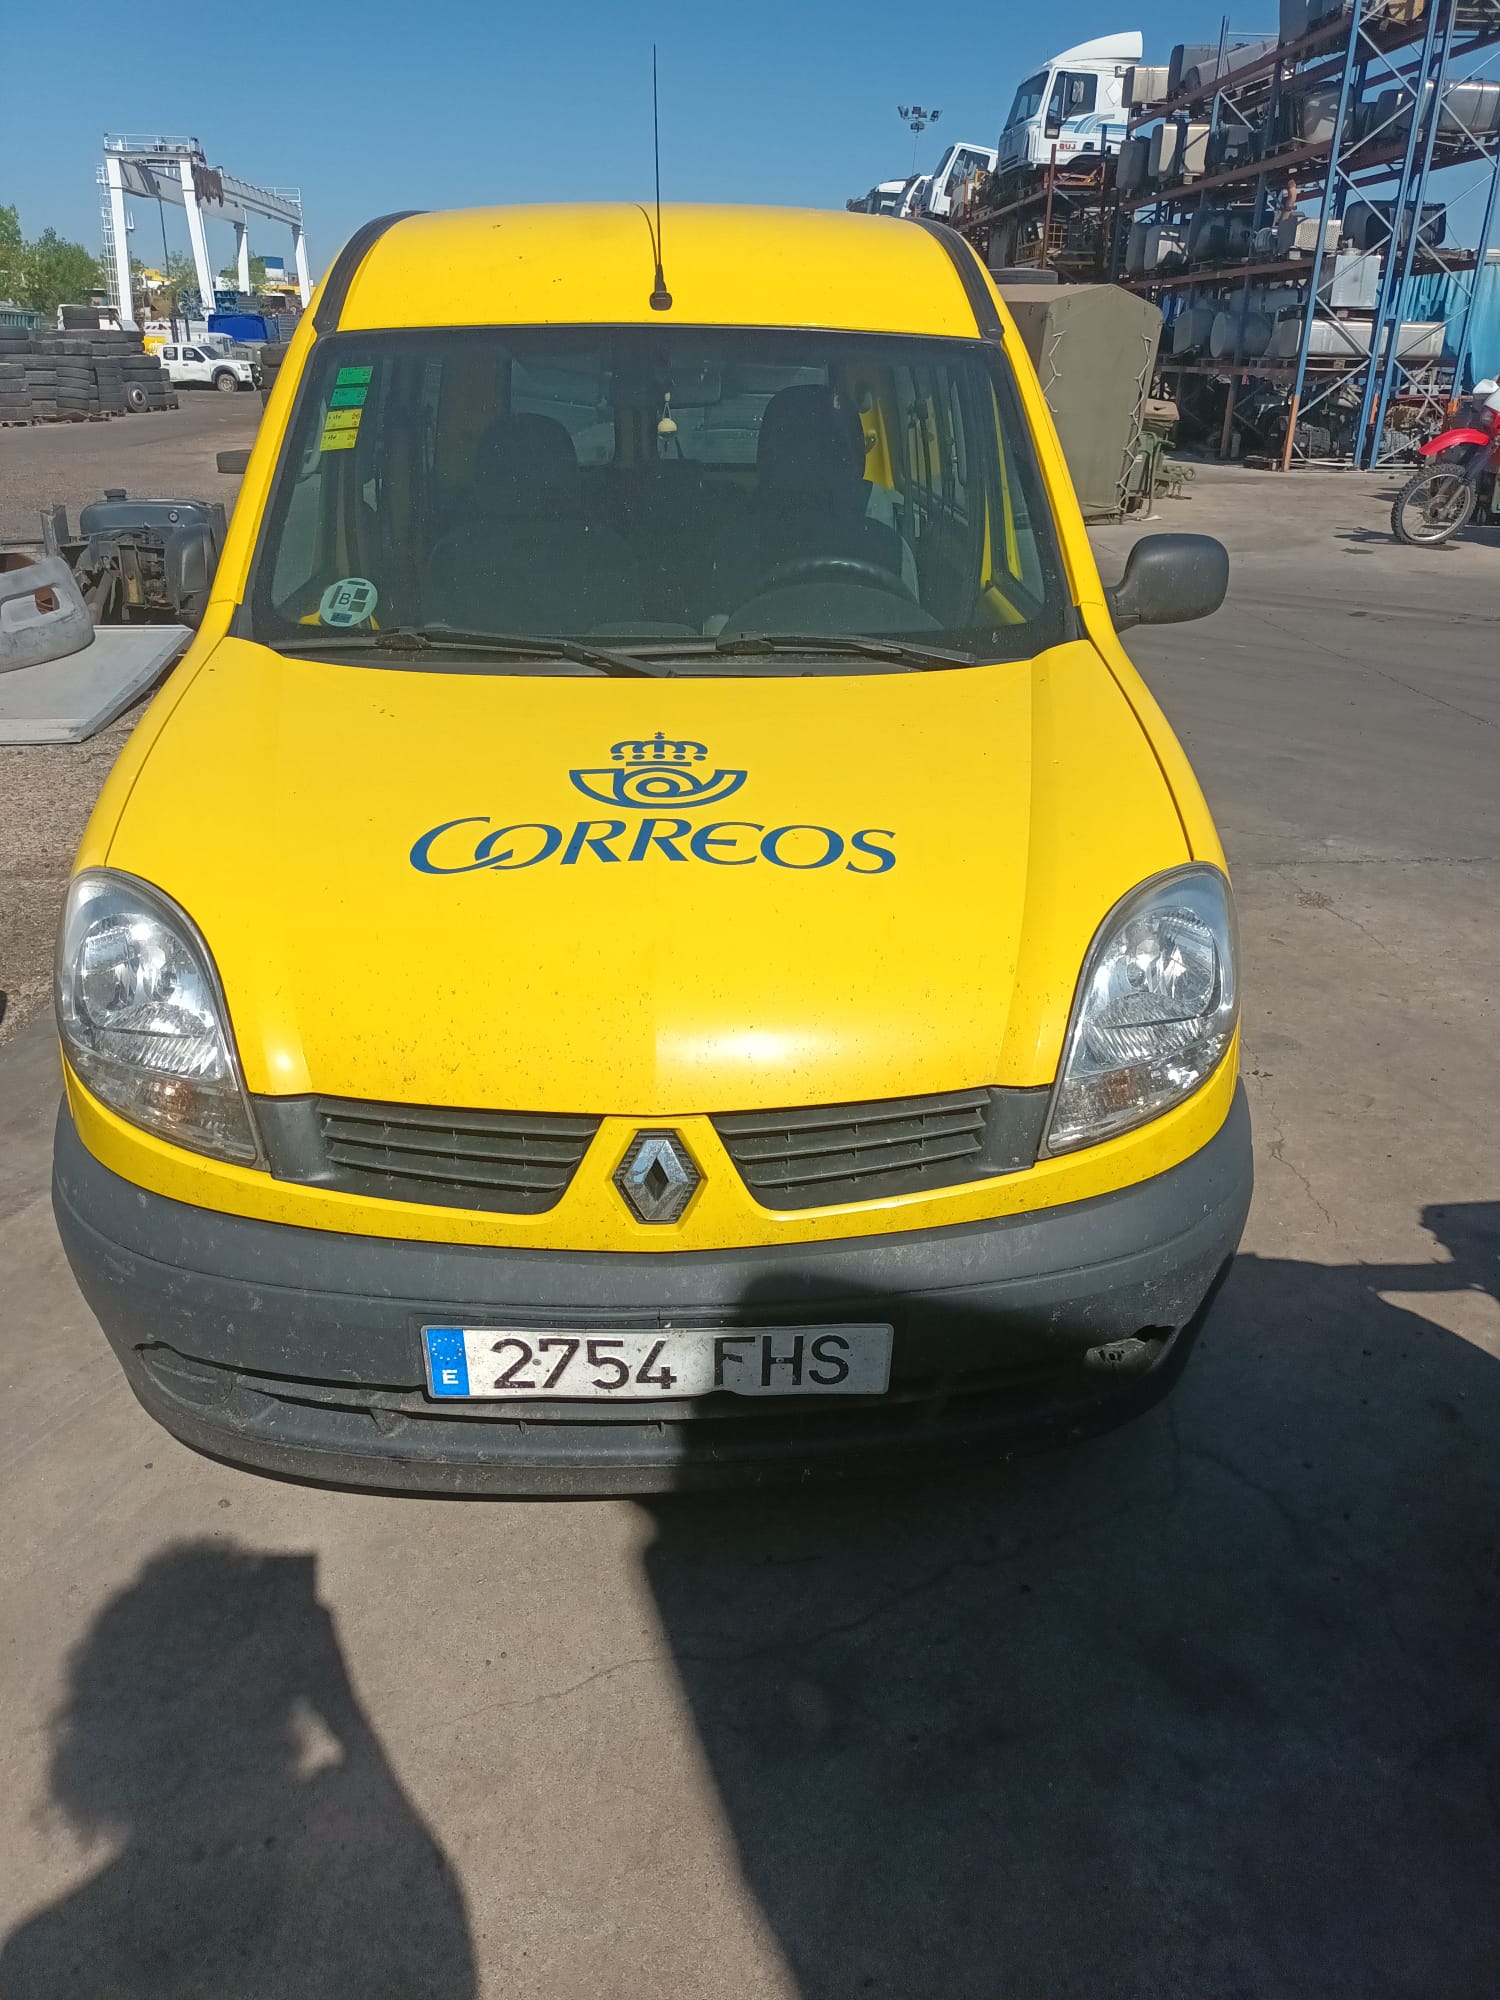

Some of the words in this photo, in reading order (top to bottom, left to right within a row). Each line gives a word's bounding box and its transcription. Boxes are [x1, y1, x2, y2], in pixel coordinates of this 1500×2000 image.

[339, 592, 351, 605] B
[409, 816, 897, 875] CORREOS
[442, 1369, 459, 1385] E
[491, 1337, 677, 1389] 2754
[713, 1335, 850, 1387] FHS
